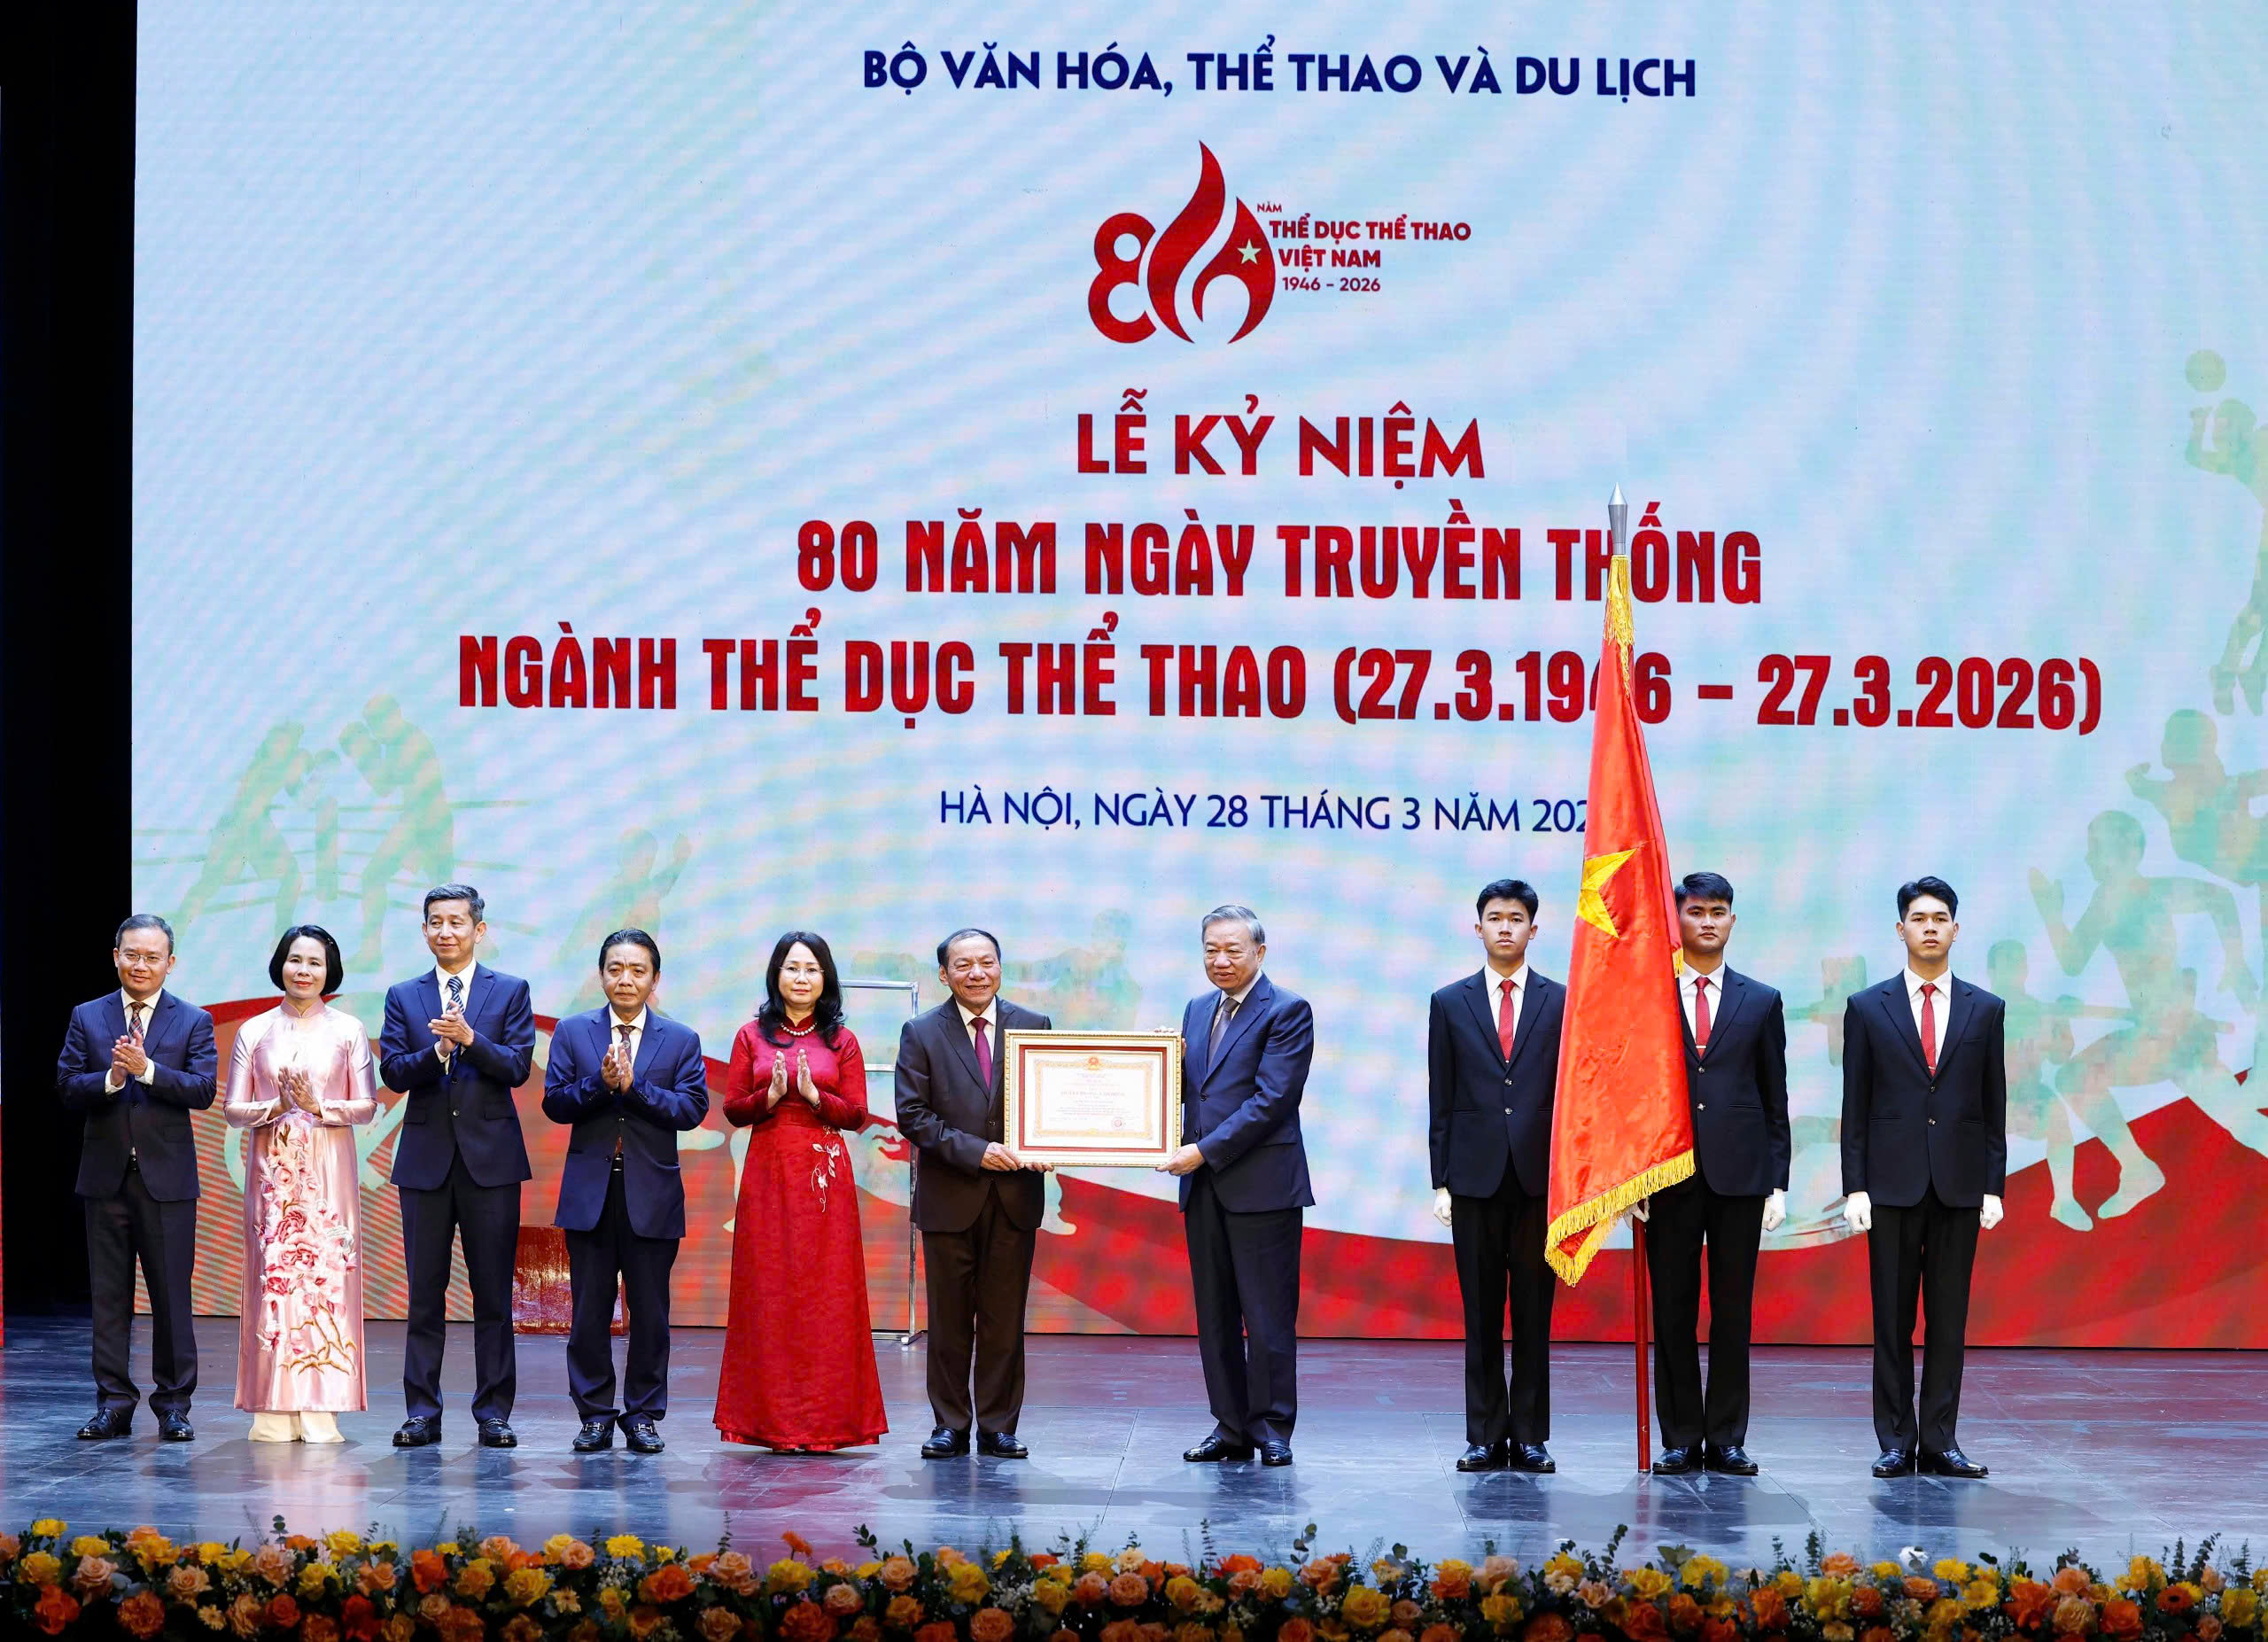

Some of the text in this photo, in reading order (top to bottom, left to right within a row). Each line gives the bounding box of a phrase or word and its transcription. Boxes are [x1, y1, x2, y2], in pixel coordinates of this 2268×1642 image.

[865, 34, 1696, 103] BỘ VĂN HÓA, THỂ THAO VÀ DU LỊCH
[1256, 200, 1283, 213] NĂM
[1269, 213, 1472, 245] THỂ DỤC THỂ THAO
[1278, 245, 1381, 272] VIỆT NAM
[1282, 276, 1321, 292] 1946
[1340, 277, 1381, 292] 2026
[1078, 388, 1486, 489] LỄ KỶ NIỆM
[799, 499, 1761, 604] 80 NĂM NGÀY TRUYỀN THỐNG
[460, 622, 676, 709] NGÀNH
[703, 608, 821, 712] THỂ
[845, 641, 974, 729] DỤC
[999, 611, 1118, 715] THỂ
[1141, 644, 1306, 719] THAO
[1334, 648, 1672, 725] (27.3.196
[1758, 654, 2101, 735] 27.3.2026)
[942, 784, 991, 824] HÀ
[1005, 786, 1080, 830] NỘI,
[1095, 787, 1196, 827] NGÀY
[1208, 795, 1247, 828] 28
[1261, 790, 1389, 830] THÁNG
[1402, 798, 1421, 830] 3
[1435, 792, 1520, 832] NĂM
